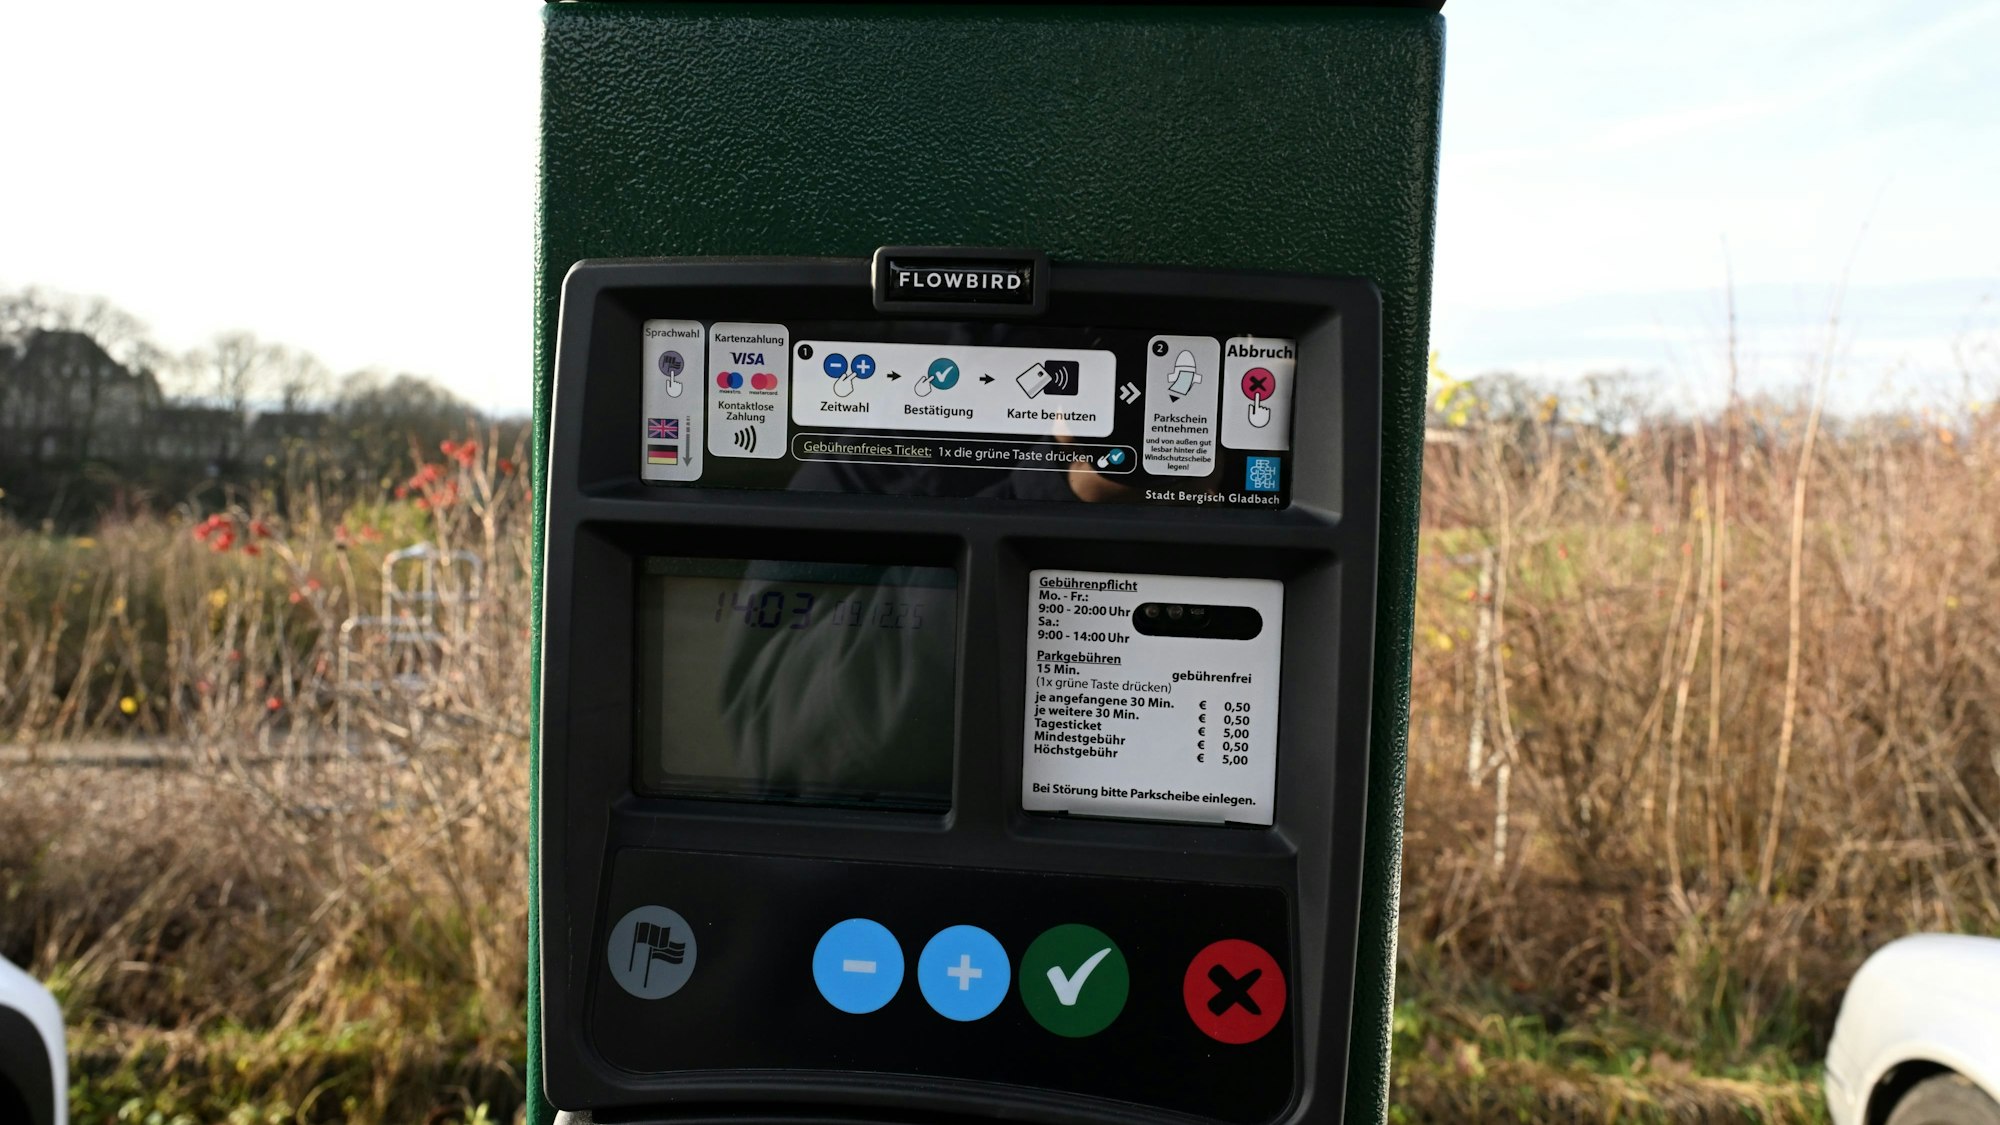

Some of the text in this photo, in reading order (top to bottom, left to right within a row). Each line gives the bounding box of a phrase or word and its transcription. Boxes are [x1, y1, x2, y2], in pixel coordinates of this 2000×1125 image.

[900, 272, 1021, 289] FLOWBIRD
[645, 328, 700, 338] Sprachwahl
[715, 334, 784, 346] Kartenzahlung
[730, 352, 765, 365] VISA
[803, 348, 807, 356] 1
[1227, 345, 1292, 359] Abbruch
[718, 401, 774, 411] Kontaktlose
[820, 402, 869, 412] Zeitwahl
[904, 405, 973, 419] Bestätigung
[726, 412, 765, 423] Zahlung
[1007, 409, 1096, 421] Karte benutzen
[1154, 414, 1207, 423] Parkschein
[1152, 425, 1208, 434] entnehmen
[804, 441, 1093, 462] Gebührenfreies Ticket: 1x die grüne Taste drücken
[1145, 454, 1211, 462] Windschutzscheibe
[1168, 463, 1189, 471] legen!
[1146, 490, 1280, 504] Stadt Bergisch Gladbach
[1039, 577, 1138, 592] Gebührenpflicht
[1039, 591, 1061, 601] Mo.
[1071, 592, 1089, 602] Fr.:
[1039, 604, 1064, 614] 9:00
[1074, 605, 1107, 616] 20:00
[1109, 607, 1131, 617] Uhr
[1038, 617, 1059, 627] Sa.:
[1038, 630, 1063, 640] 9:00
[1073, 632, 1106, 642] 14:00
[1108, 633, 1130, 643] Uhr
[1036, 651, 1122, 665] Parkgebühren
[1037, 664, 1080, 675] 15 Min.
[1172, 670, 1252, 684] gebührenfrei
[1036, 676, 1171, 694] (1x grüne Taste drücken)
[1035, 693, 1174, 708] je angefangene 30 Min.
[1199, 700, 1250, 713] € 0,50
[1034, 707, 1139, 720] je weitere 30 Min.
[1199, 714, 1250, 726] € 0,50
[1035, 718, 1102, 730] Tagesticket
[1034, 731, 1126, 745] Mindestgebühr
[1198, 727, 1249, 740] € 5,00
[1034, 744, 1118, 758] Höchstgebühr
[1197, 740, 1248, 753] € 0,50
[1197, 753, 1248, 766] € 5,00
[1033, 783, 1256, 806] Bei Störung bitte Parkscheibe einlegen.
